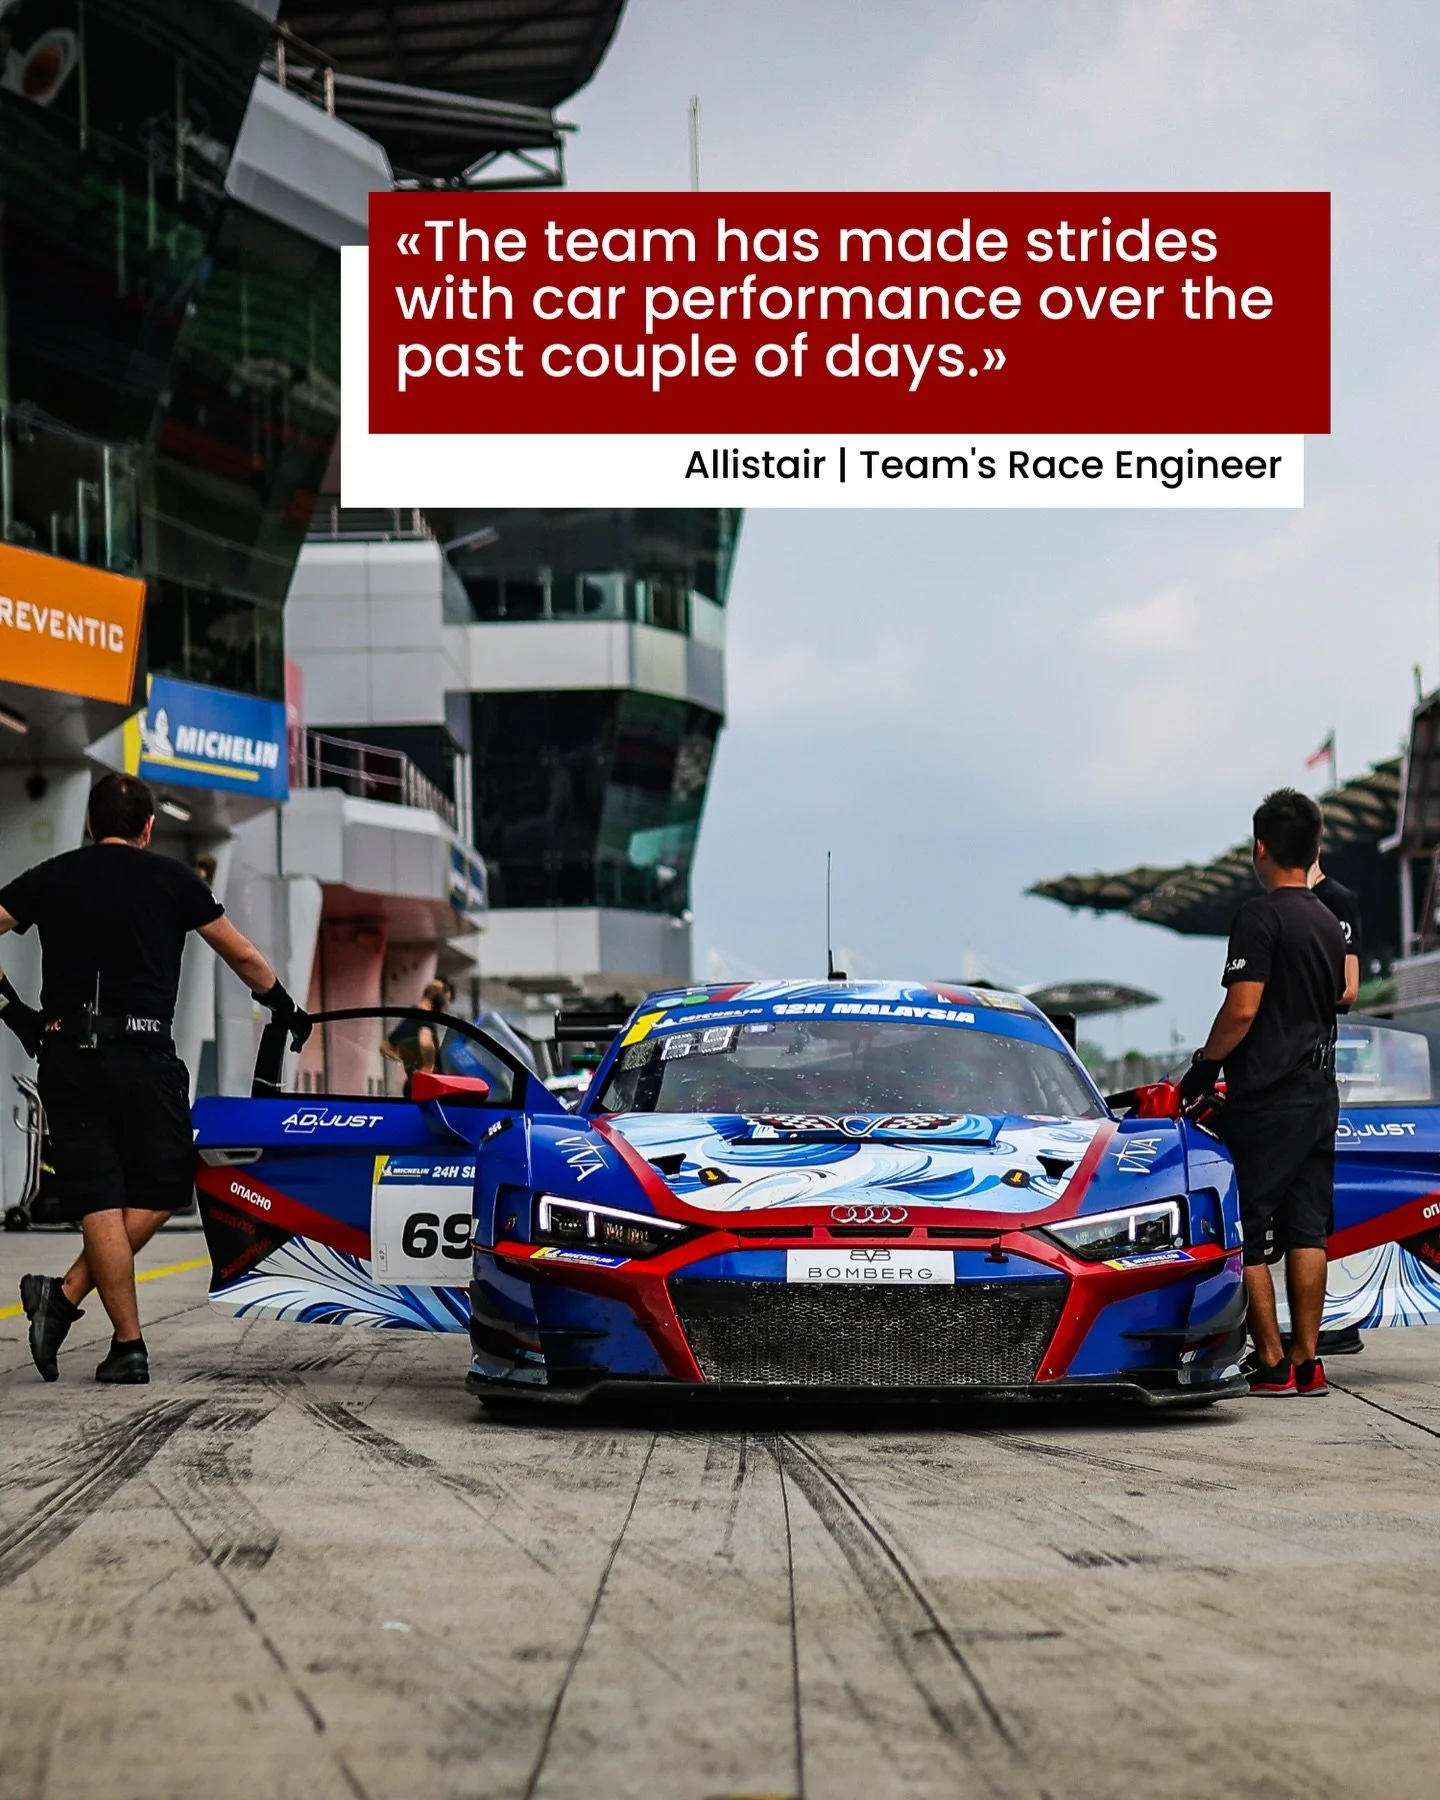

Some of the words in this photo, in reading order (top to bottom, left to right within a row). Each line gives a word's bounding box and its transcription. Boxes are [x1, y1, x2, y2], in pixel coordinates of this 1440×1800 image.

[176, 725, 279, 769] MICHELIN
[772, 1003, 826, 1015] 12H
[832, 1003, 975, 1024] MALAYSIA
[393, 1167, 430, 1175] MICHELIN
[432, 1165, 460, 1179] 24H
[230, 1181, 272, 1211] ОПАСНО
[1422, 1201, 1440, 1219] ОП
[402, 1212, 474, 1260] 69
[1133, 1253, 1180, 1265] MICHELIN
[808, 1267, 933, 1280] BOMBERG
